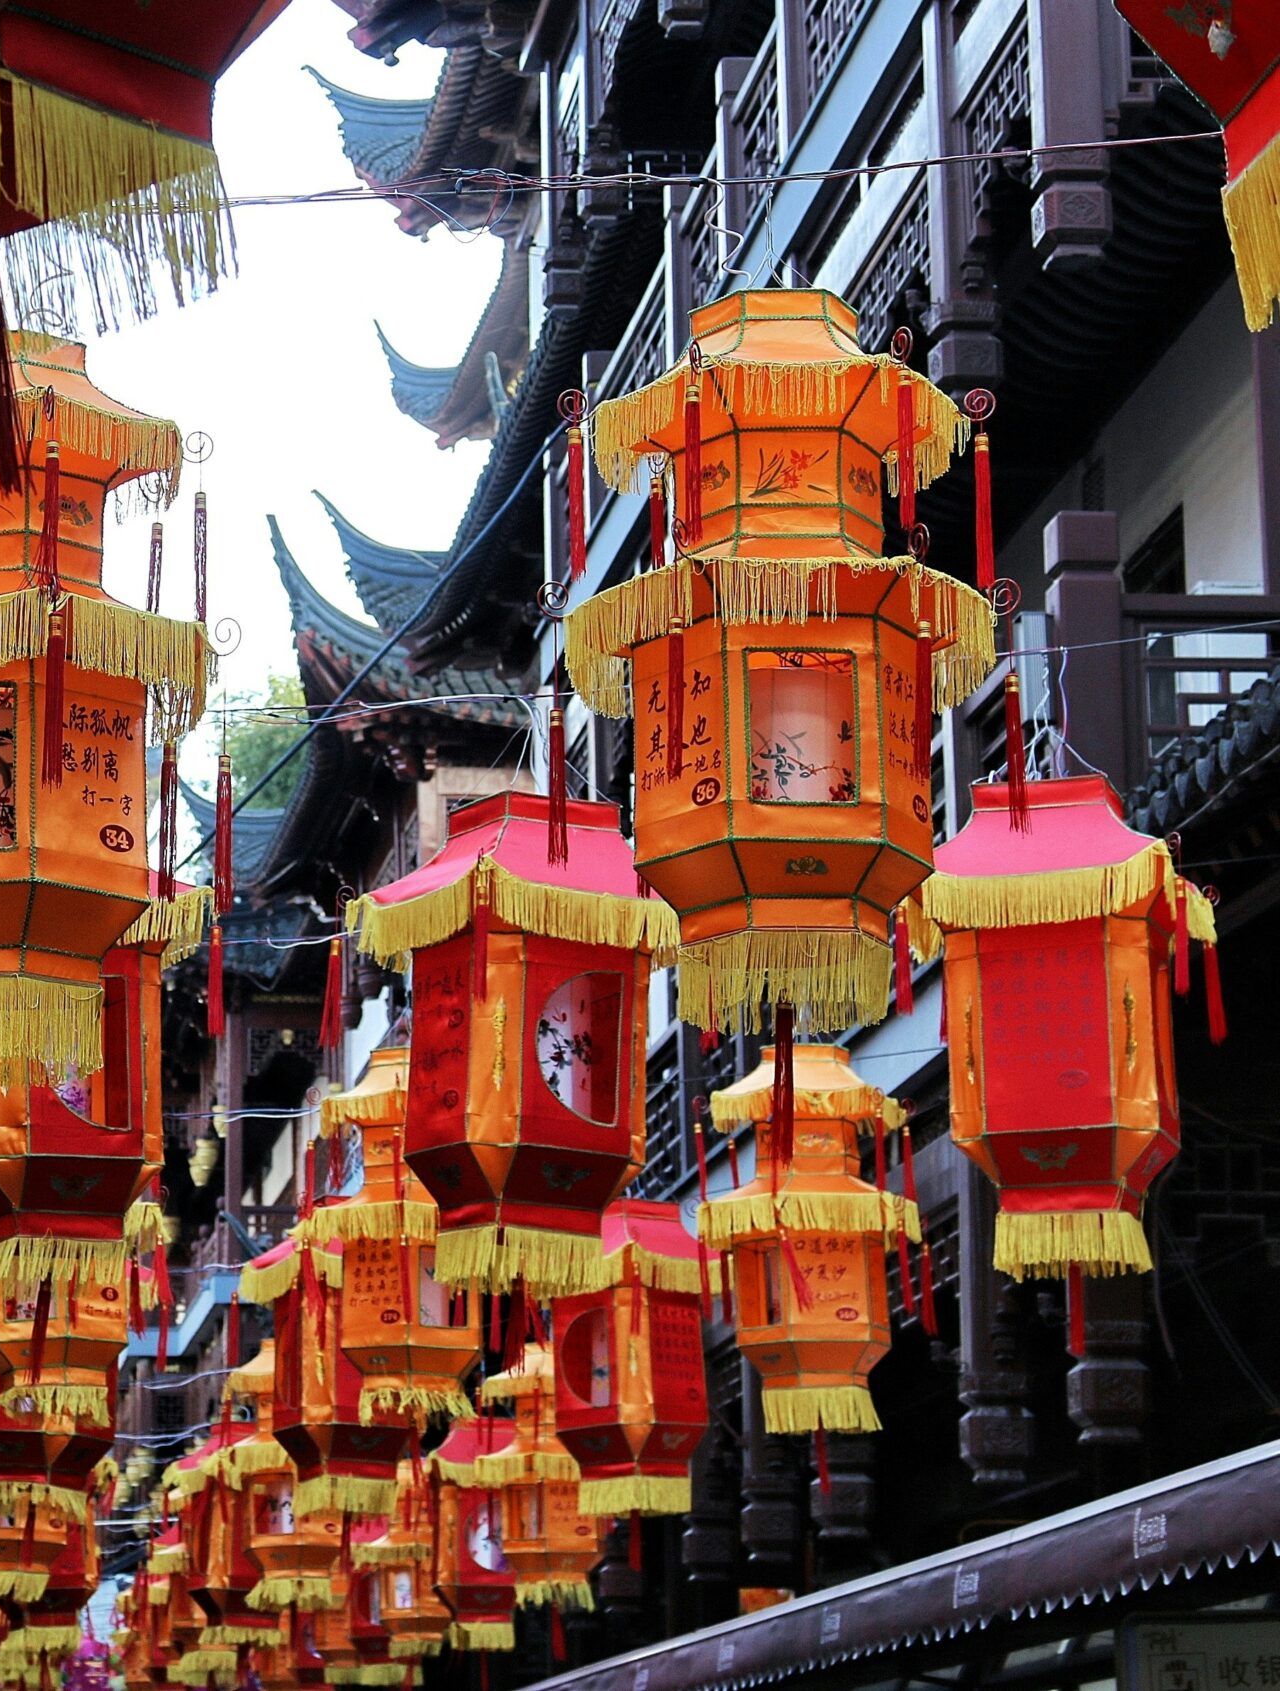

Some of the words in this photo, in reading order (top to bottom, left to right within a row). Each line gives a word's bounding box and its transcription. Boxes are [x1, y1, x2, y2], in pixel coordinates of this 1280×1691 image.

[648, 669, 711, 713] 无知
[62, 703, 133, 741] 际孤帆
[646, 715, 712, 761] 其也
[82, 785, 133, 816] 打一字
[695, 780, 717, 804] 36
[104, 828, 130, 851] 34
